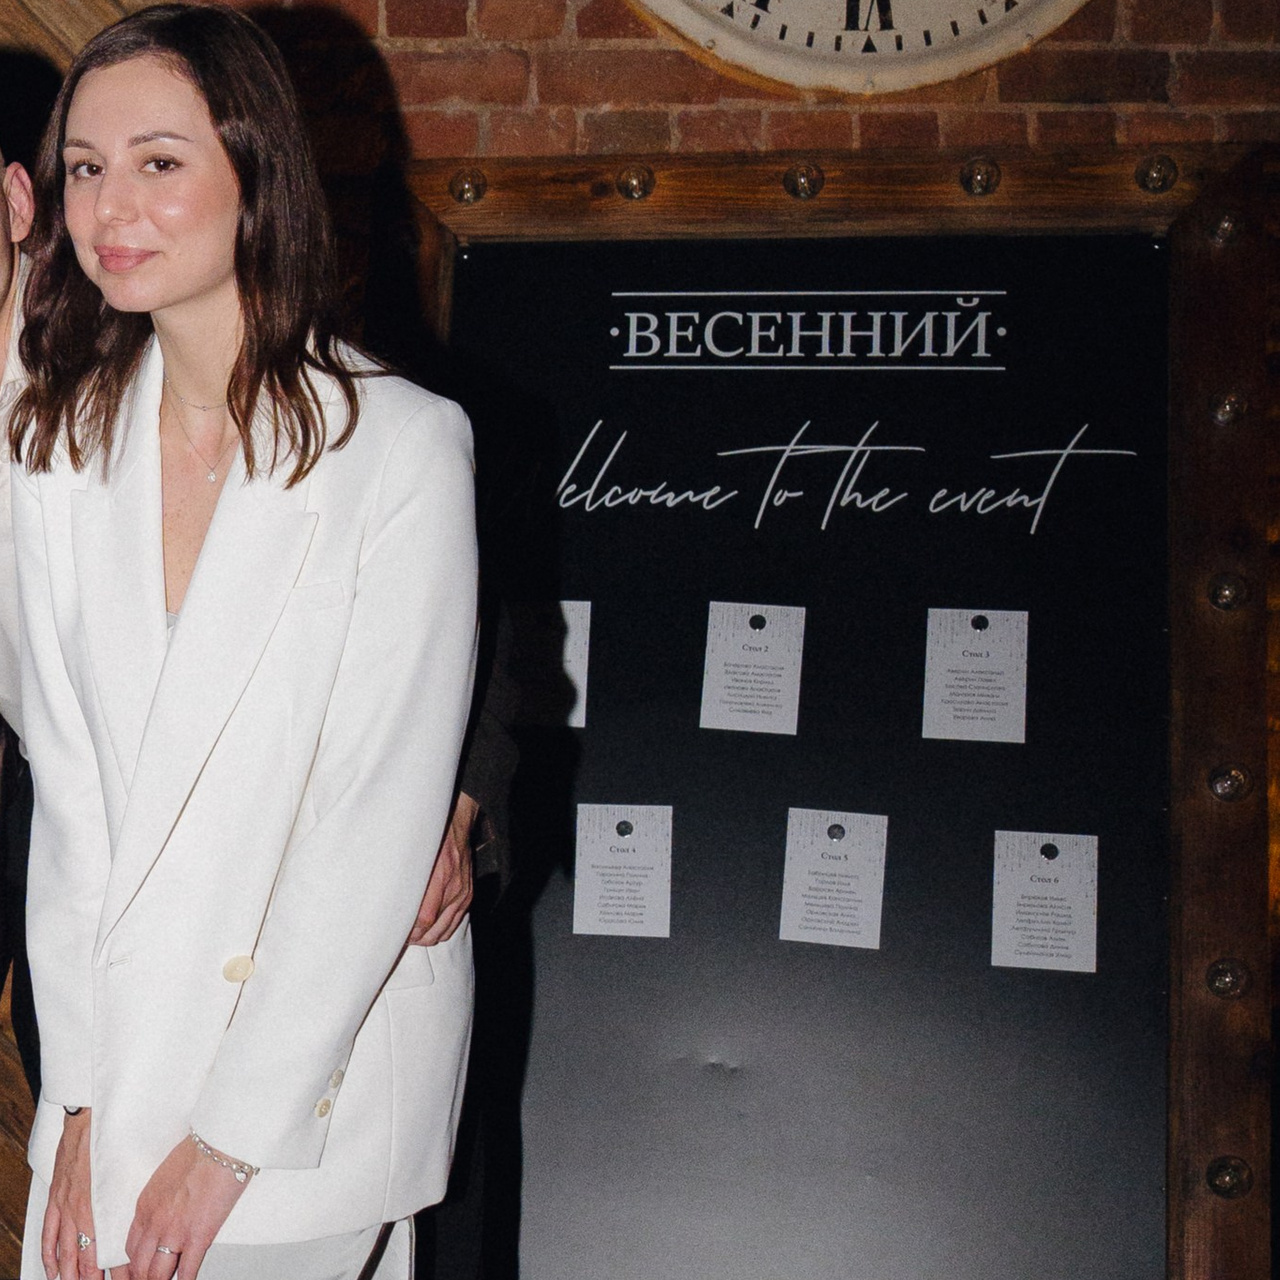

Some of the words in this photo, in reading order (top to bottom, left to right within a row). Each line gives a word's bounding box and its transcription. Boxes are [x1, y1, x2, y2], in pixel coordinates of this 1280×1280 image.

[623, 297, 992, 357] ВЕСЕННИЙ
[555, 419, 738, 512] elcome
[928, 424, 1137, 534] event
